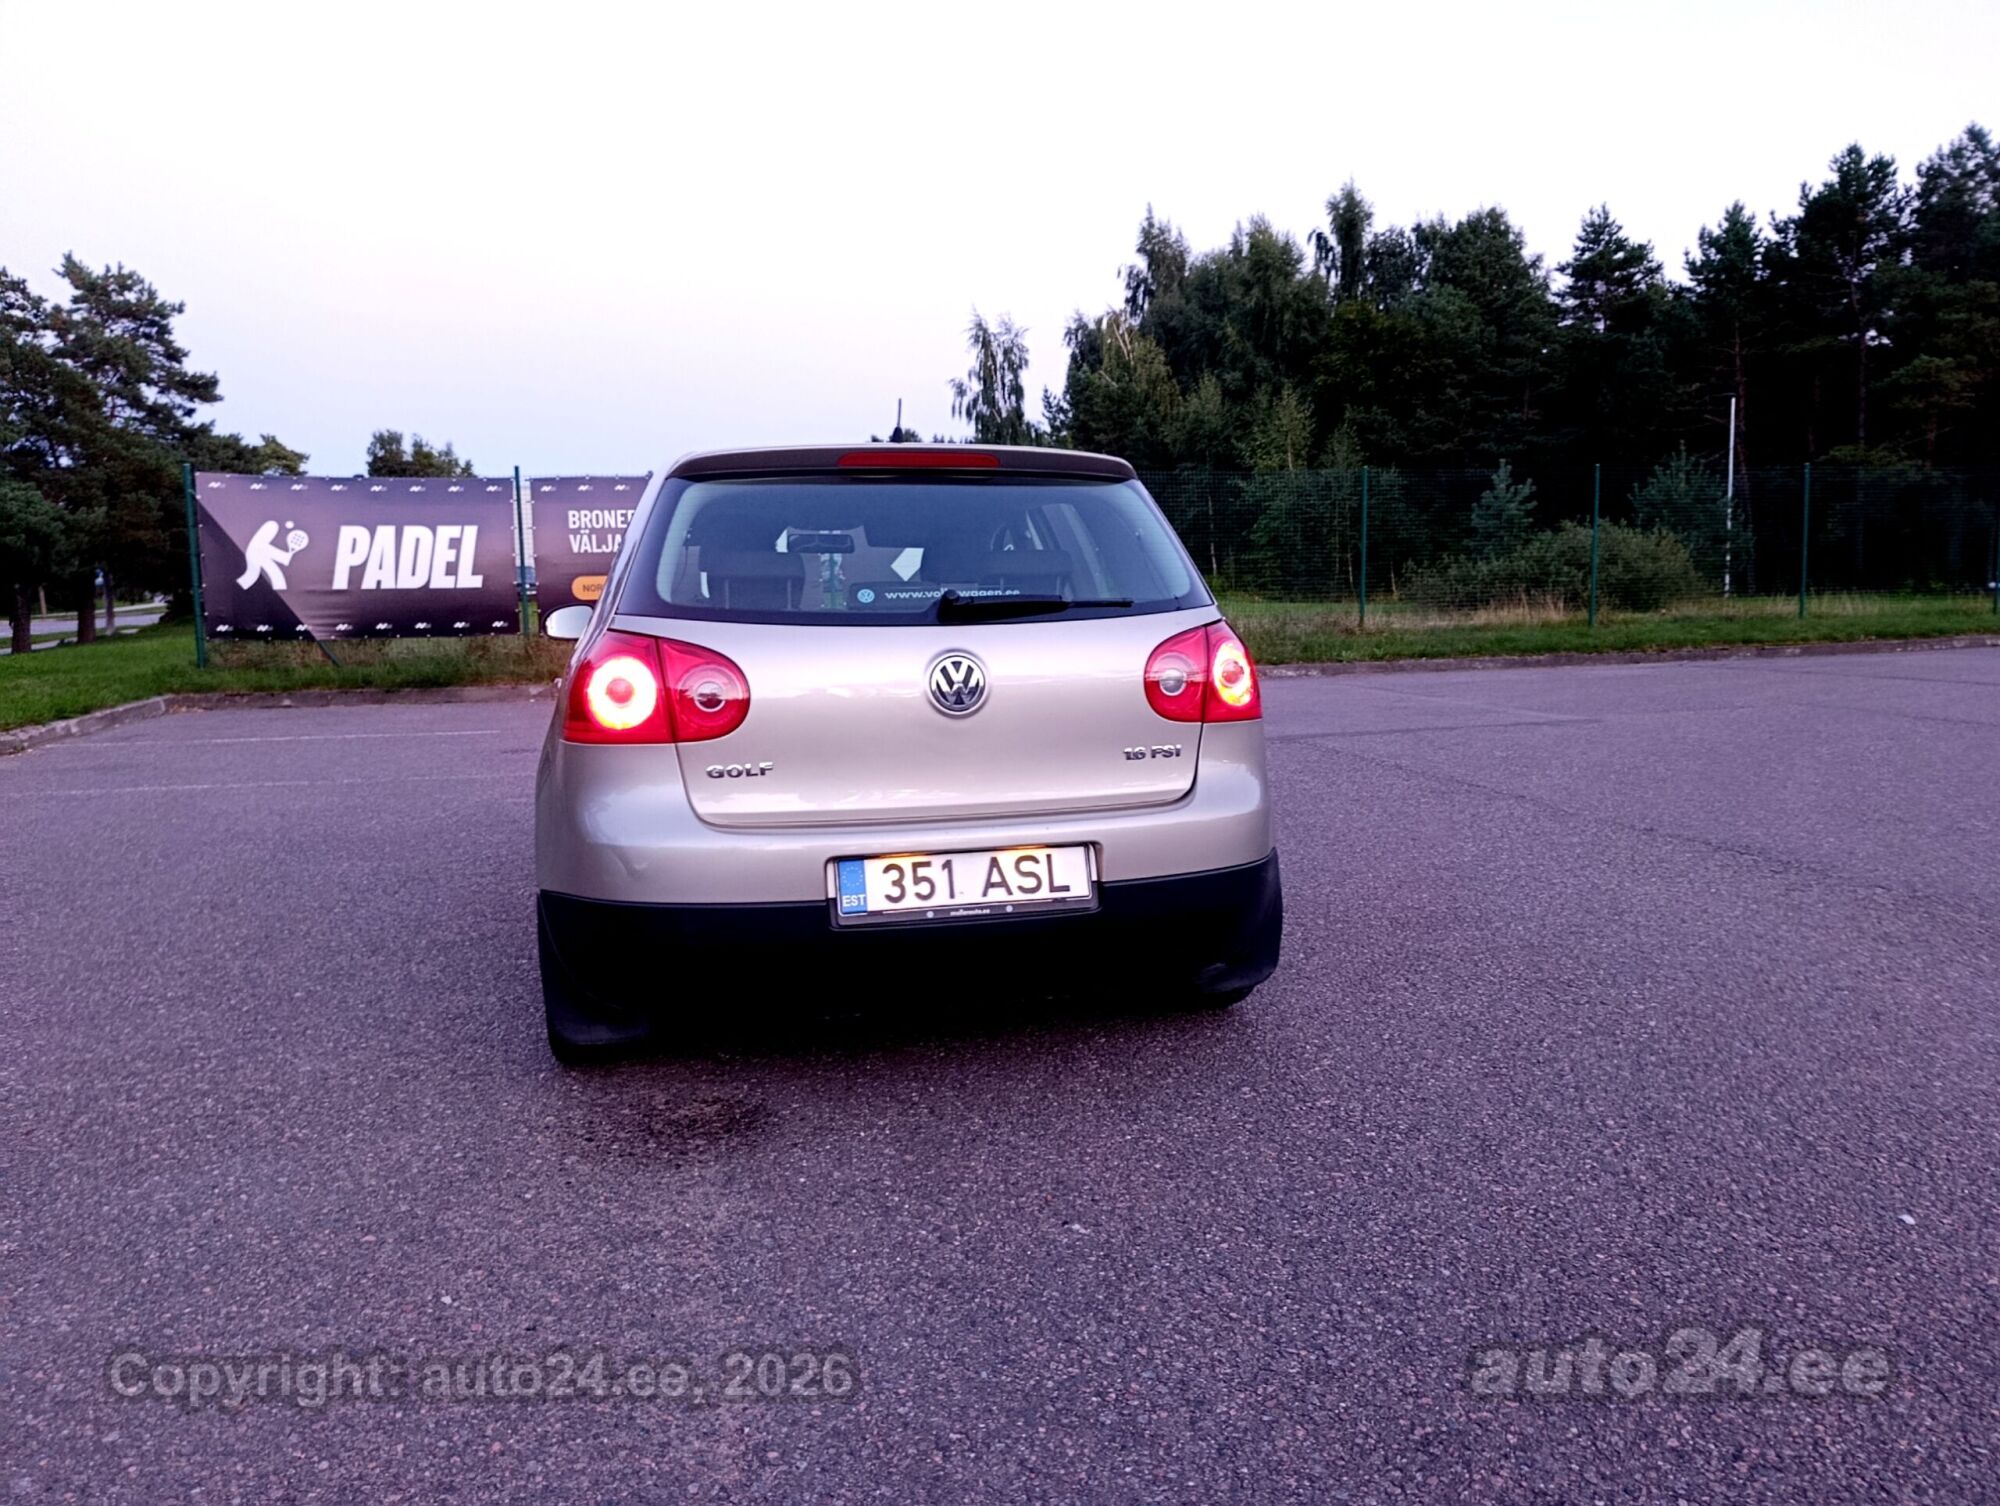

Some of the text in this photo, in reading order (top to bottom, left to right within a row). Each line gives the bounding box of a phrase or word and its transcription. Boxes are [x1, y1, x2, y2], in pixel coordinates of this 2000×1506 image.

[332, 525, 484, 590] PADEL
[705, 761, 774, 779] GOLF
[882, 854, 1071, 904] 351 ASL
[842, 894, 866, 907] EST
